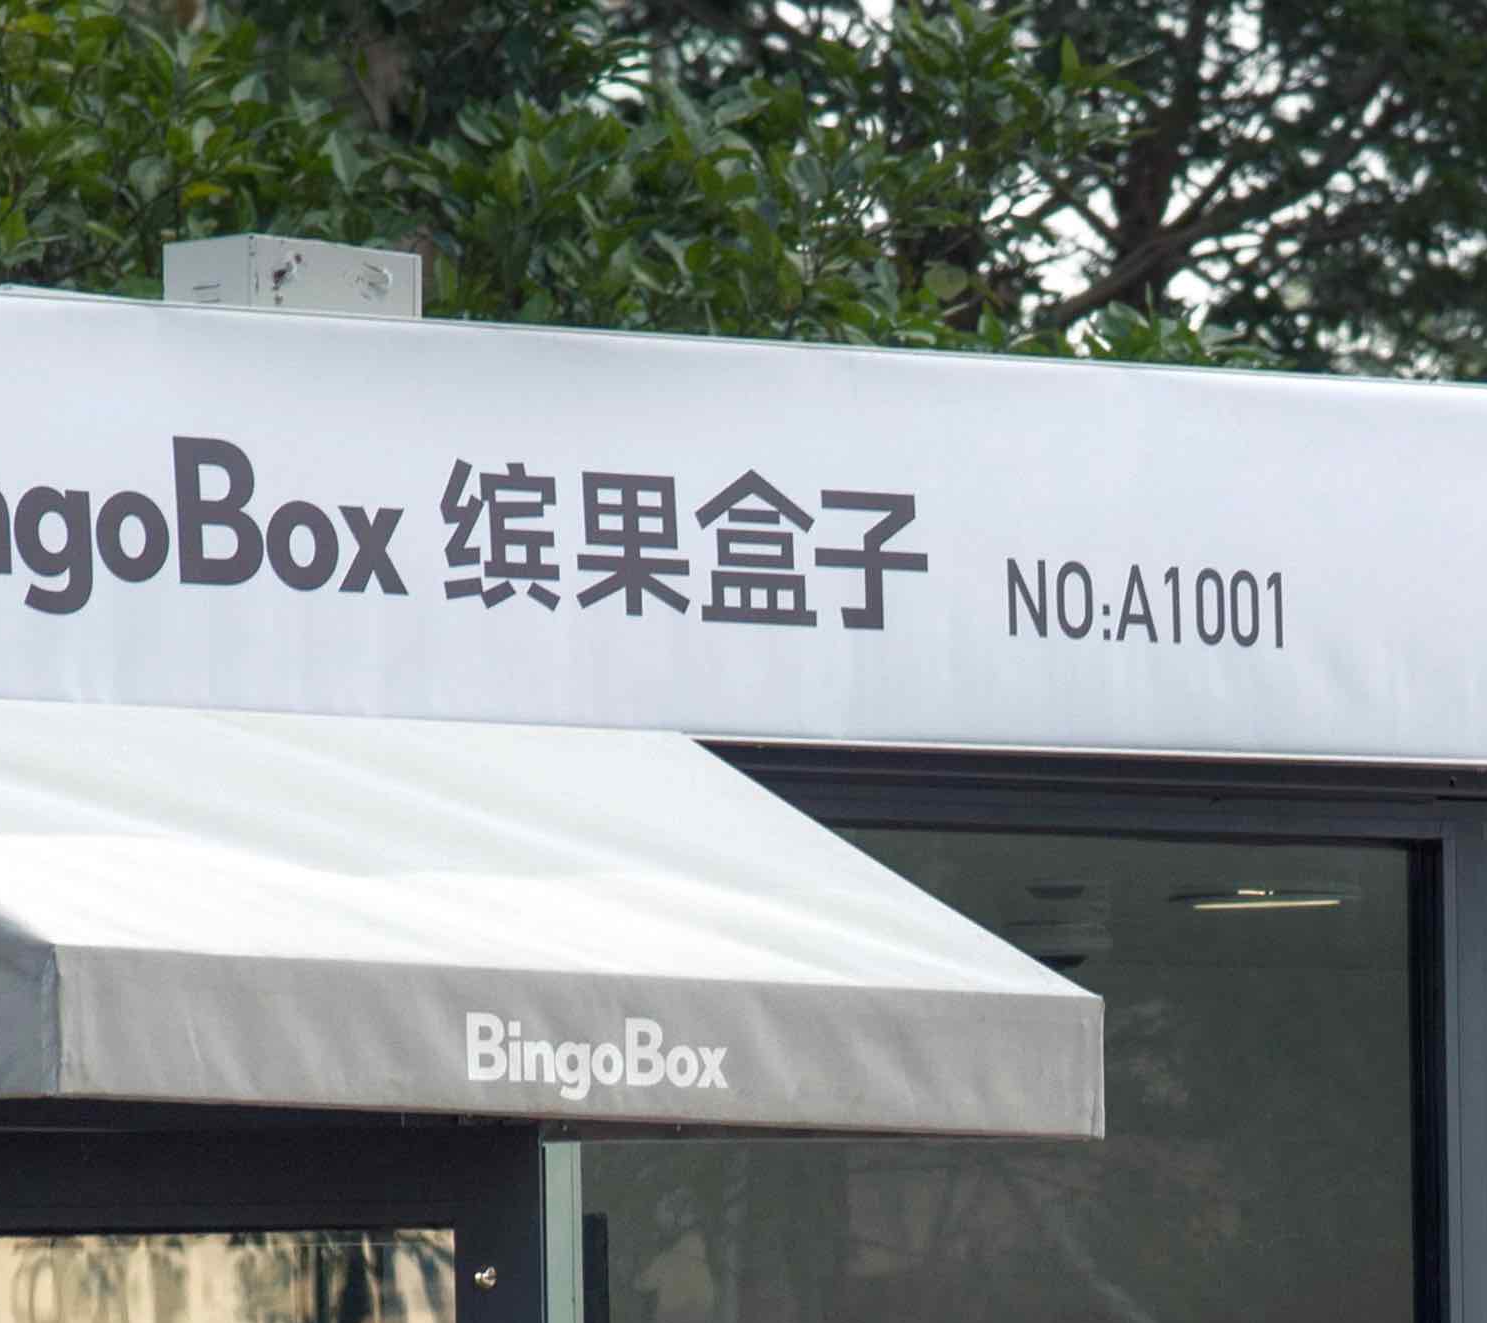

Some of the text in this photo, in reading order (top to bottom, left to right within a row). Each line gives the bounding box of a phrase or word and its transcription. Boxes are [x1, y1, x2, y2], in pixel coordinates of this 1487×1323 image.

[439, 459, 929, 631] 缤果盒子
[1008, 557, 1289, 651] NO:A1001
[465, 1011, 729, 1101] BingoBox
